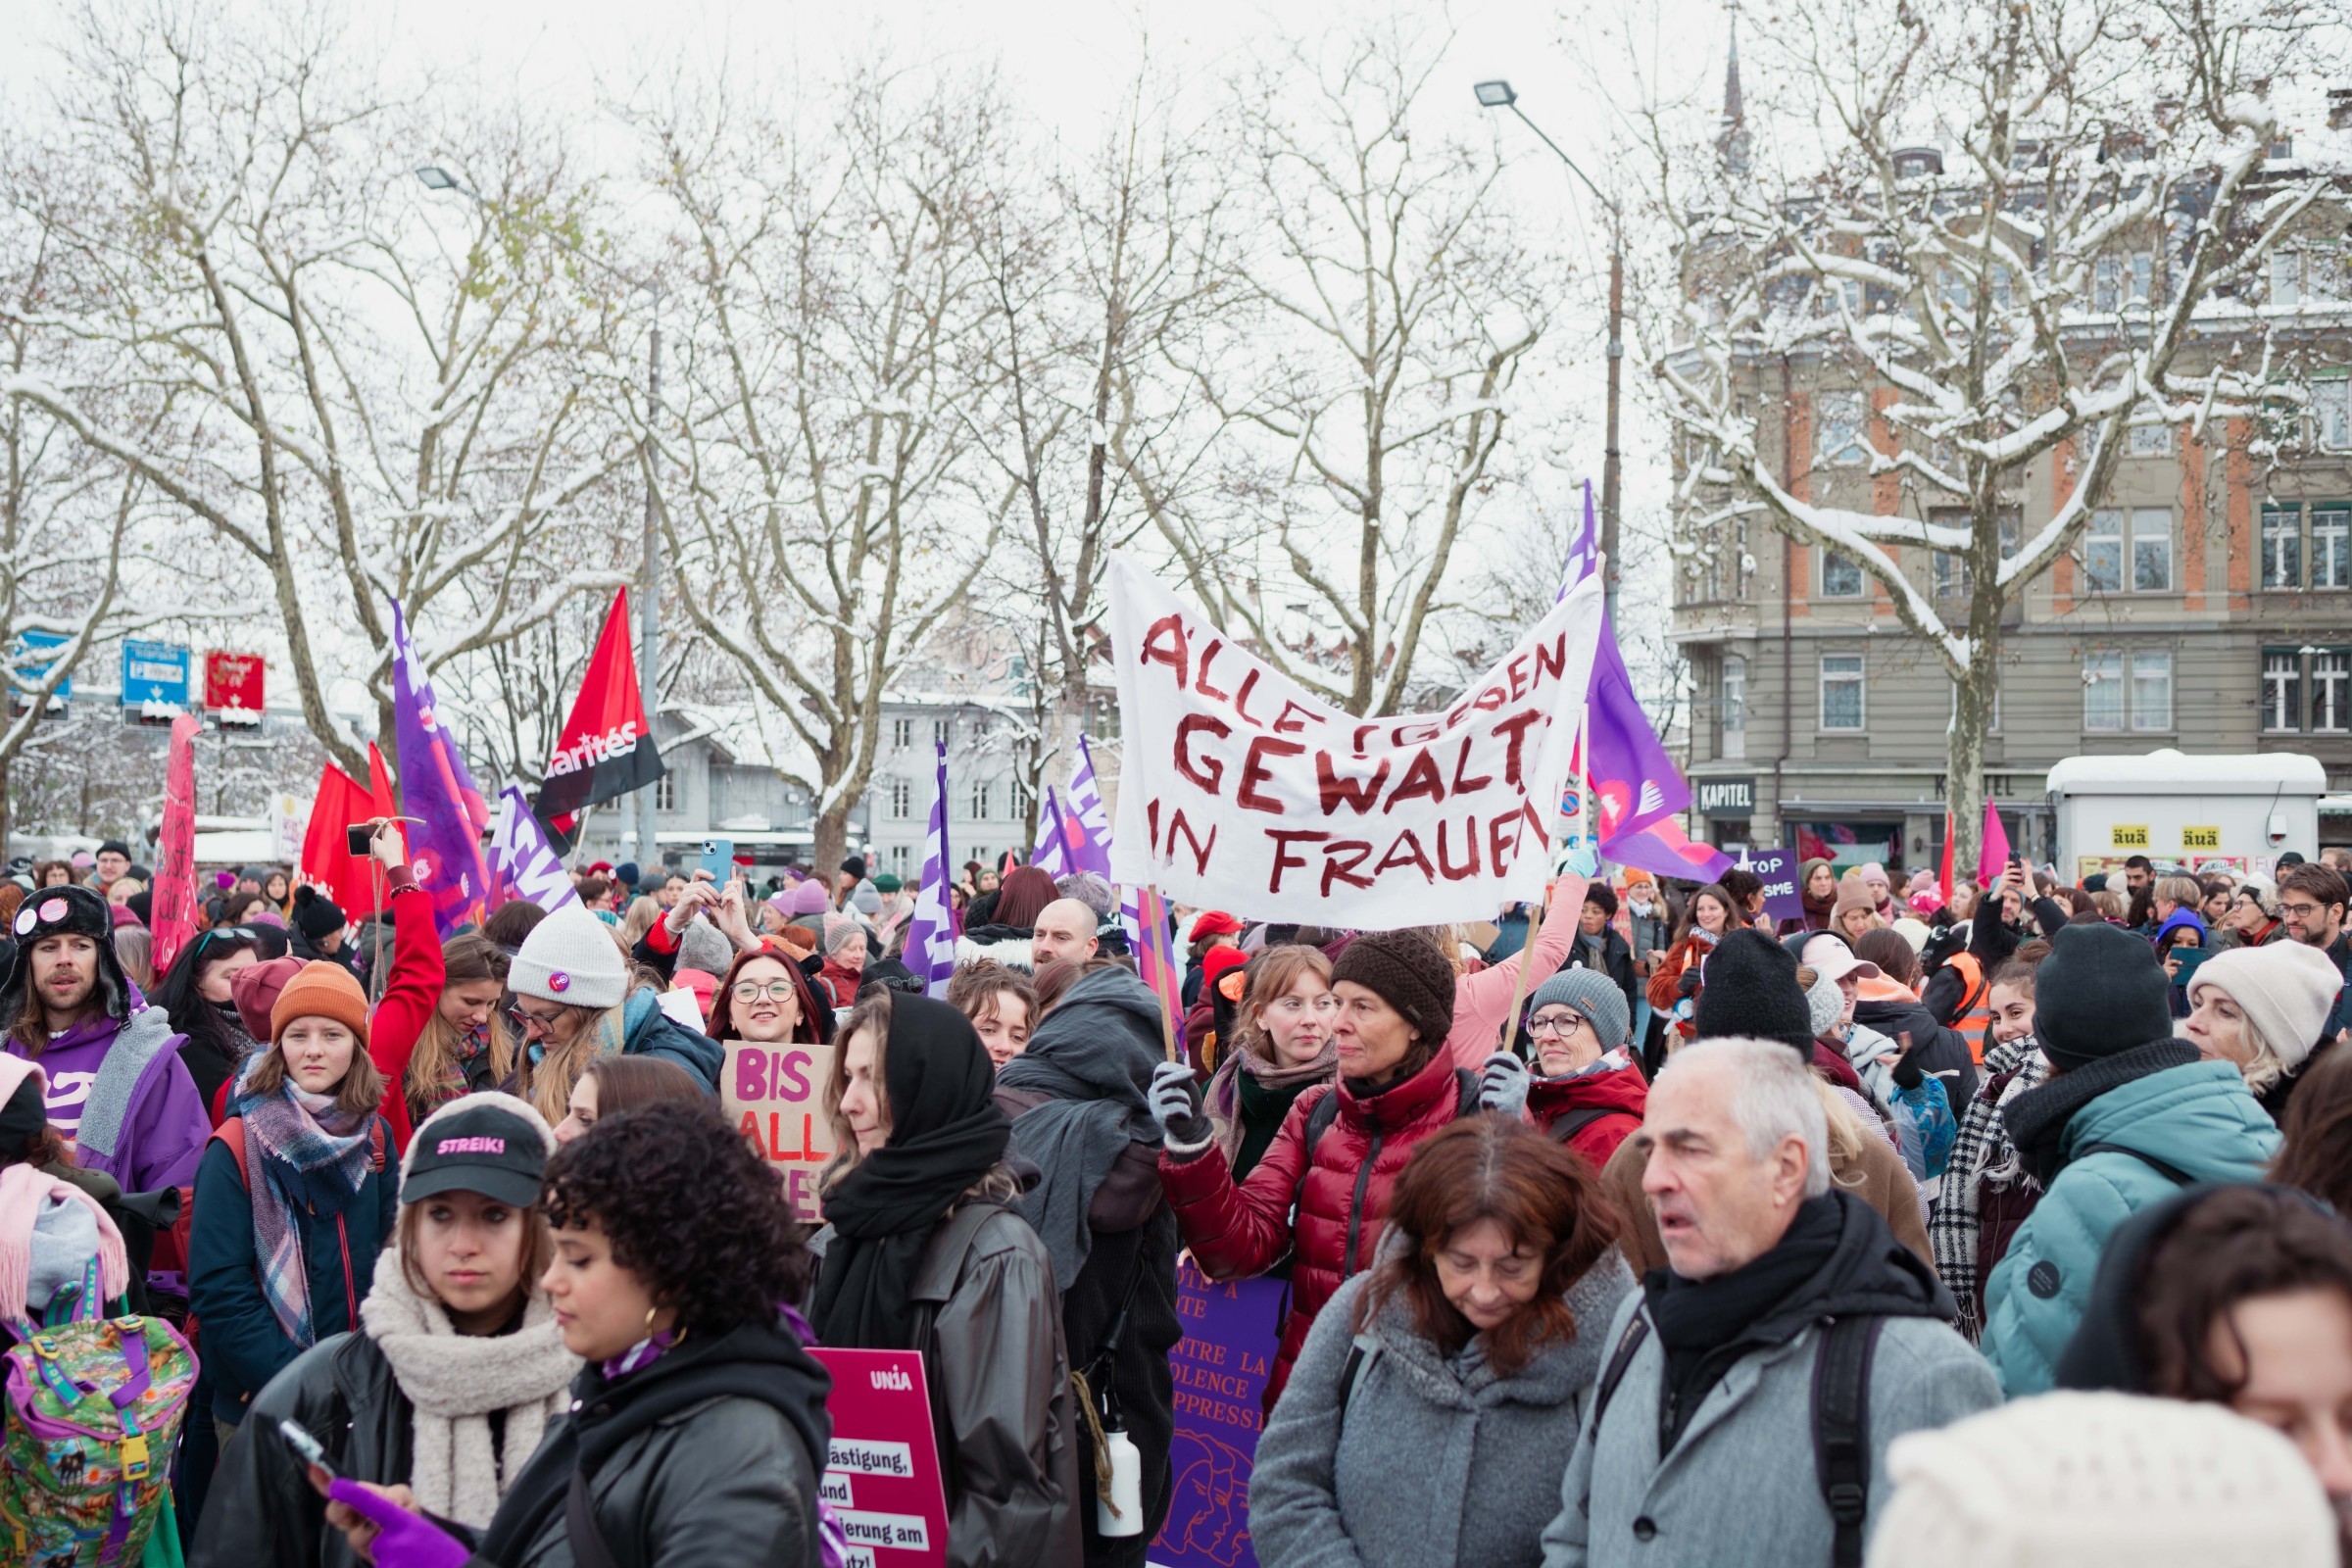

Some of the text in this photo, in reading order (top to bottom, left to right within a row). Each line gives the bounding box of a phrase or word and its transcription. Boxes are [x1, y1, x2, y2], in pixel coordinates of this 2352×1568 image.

[1174, 708, 1544, 816] GEWALT
[1701, 784, 1751, 809] KAPITEL
[1935, 774, 2015, 797] KTEL
[1264, 796, 1548, 898] FRAUEN
[2114, 829, 2146, 844] äuä
[2183, 831, 2217, 846] äuä
[1733, 858, 1784, 873] TOP
[1764, 881, 1794, 898] SME
[736, 1048, 812, 1102] BIS
[437, 1137, 505, 1154] STREIK!
[740, 1110, 847, 1162] ALL
[1176, 1295, 1207, 1318] TE
[1239, 1351, 1266, 1377] LA
[819, 1483, 848, 1500] und
[897, 1528, 923, 1544] am
